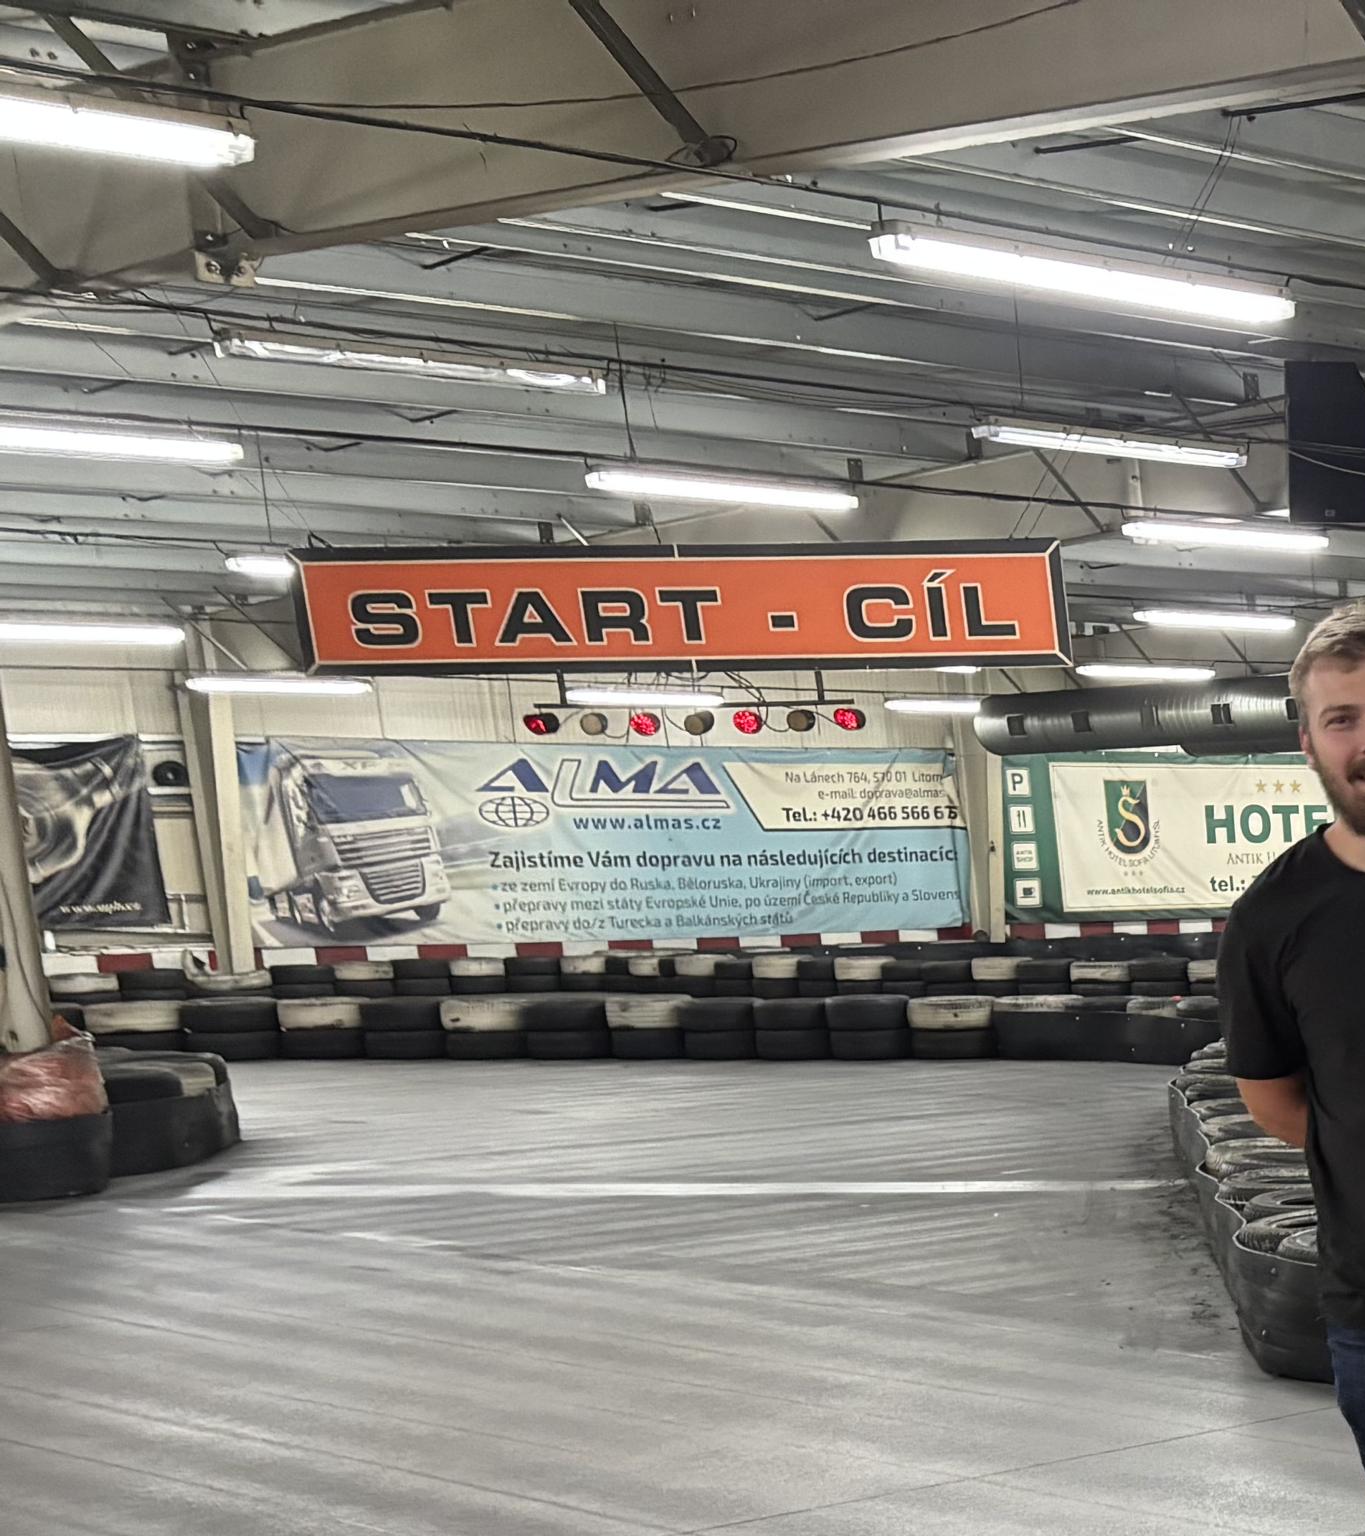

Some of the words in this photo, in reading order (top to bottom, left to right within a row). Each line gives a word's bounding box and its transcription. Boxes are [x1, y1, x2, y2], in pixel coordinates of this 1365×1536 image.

[349, 587, 721, 648] START
[768, 611, 799, 632] -
[845, 569, 1019, 642] CÍL
[475, 757, 729, 808] ALMA
[785, 773, 801, 783] Na
[805, 771, 844, 783] Lánech
[1011, 773, 1023, 791] P
[573, 814, 722, 830] www.almas.cz
[782, 808, 817, 822] Tel.:
[821, 807, 863, 822] +420
[868, 806, 897, 821] 466
[902, 806, 932, 820] 566
[488, 851, 584, 872] Zajistíme
[587, 850, 631, 868] Vám
[636, 850, 715, 871] dopravu
[720, 853, 743, 867] na
[747, 849, 863, 868] následujících
[1106, 847, 1128, 867] HOTEL
[501, 880, 517, 891] ze
[520, 879, 555, 891] zemí
[559, 878, 606, 893] Evropy
[610, 878, 627, 891] do
[751, 876, 800, 891] Ukrajiny
[855, 871, 897, 887] export)
[1210, 875, 1246, 892] tel.:
[503, 898, 567, 913] přepravy
[571, 898, 603, 910] mezi
[607, 897, 643, 912] státy
[646, 895, 706, 911] Evropské
[745, 897, 761, 910] po
[764, 894, 801, 907] území
[803, 891, 840, 905] České
[843, 889, 900, 906] Republiky
[902, 893, 909, 901] a
[506, 917, 569, 932] přepravy
[573, 915, 605, 930] do/z
[608, 915, 661, 928] Turecka
[665, 919, 673, 927] a
[676, 913, 755, 929] Balkánských
